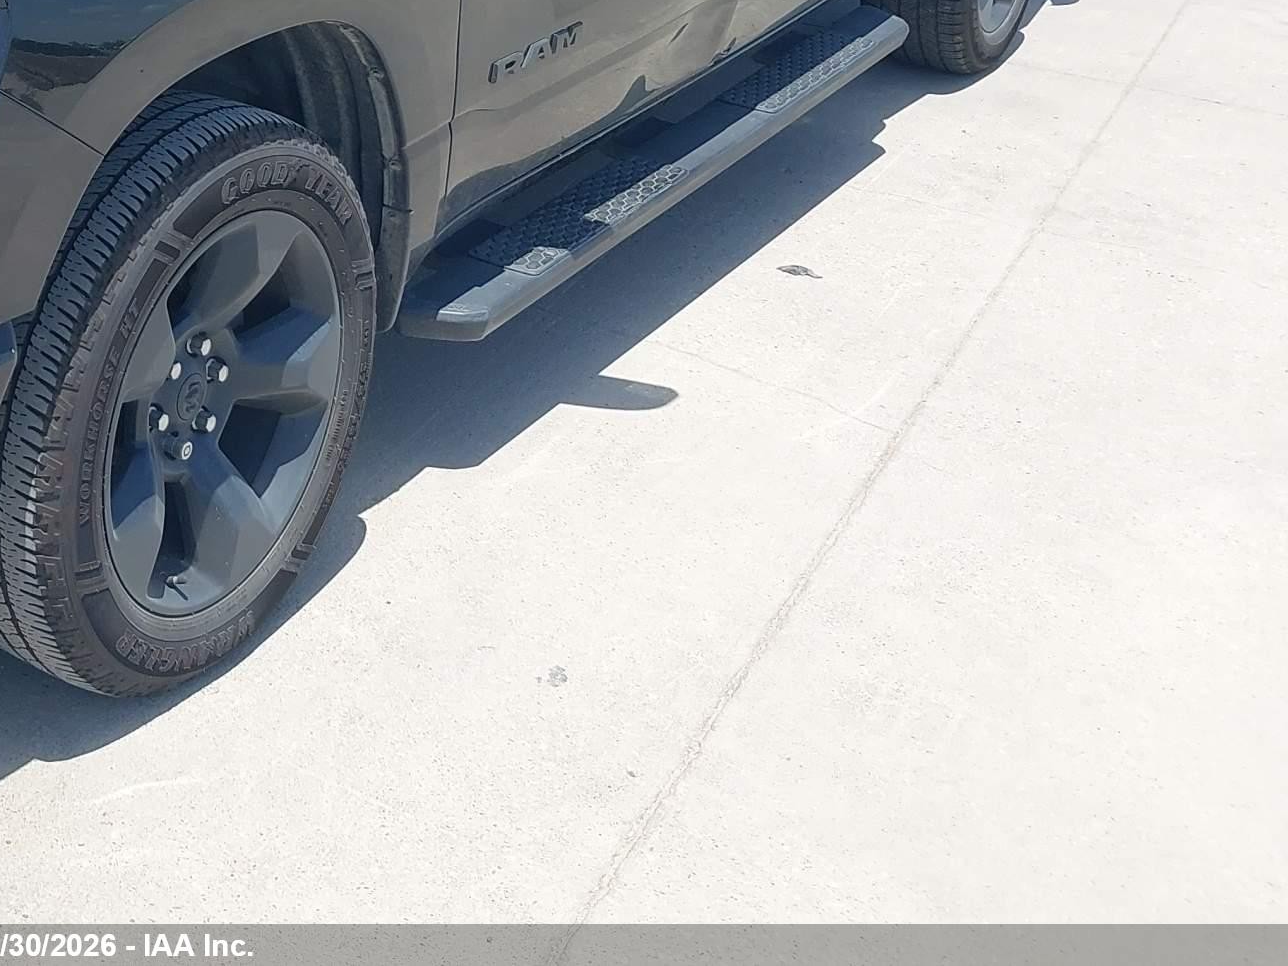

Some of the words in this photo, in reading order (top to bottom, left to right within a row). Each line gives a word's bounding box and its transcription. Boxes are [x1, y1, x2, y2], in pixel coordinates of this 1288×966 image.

[488, 20, 583, 84] RAM
[79, 347, 120, 526] WORKHORSE
[115, 610, 256, 672] WRANGLER
